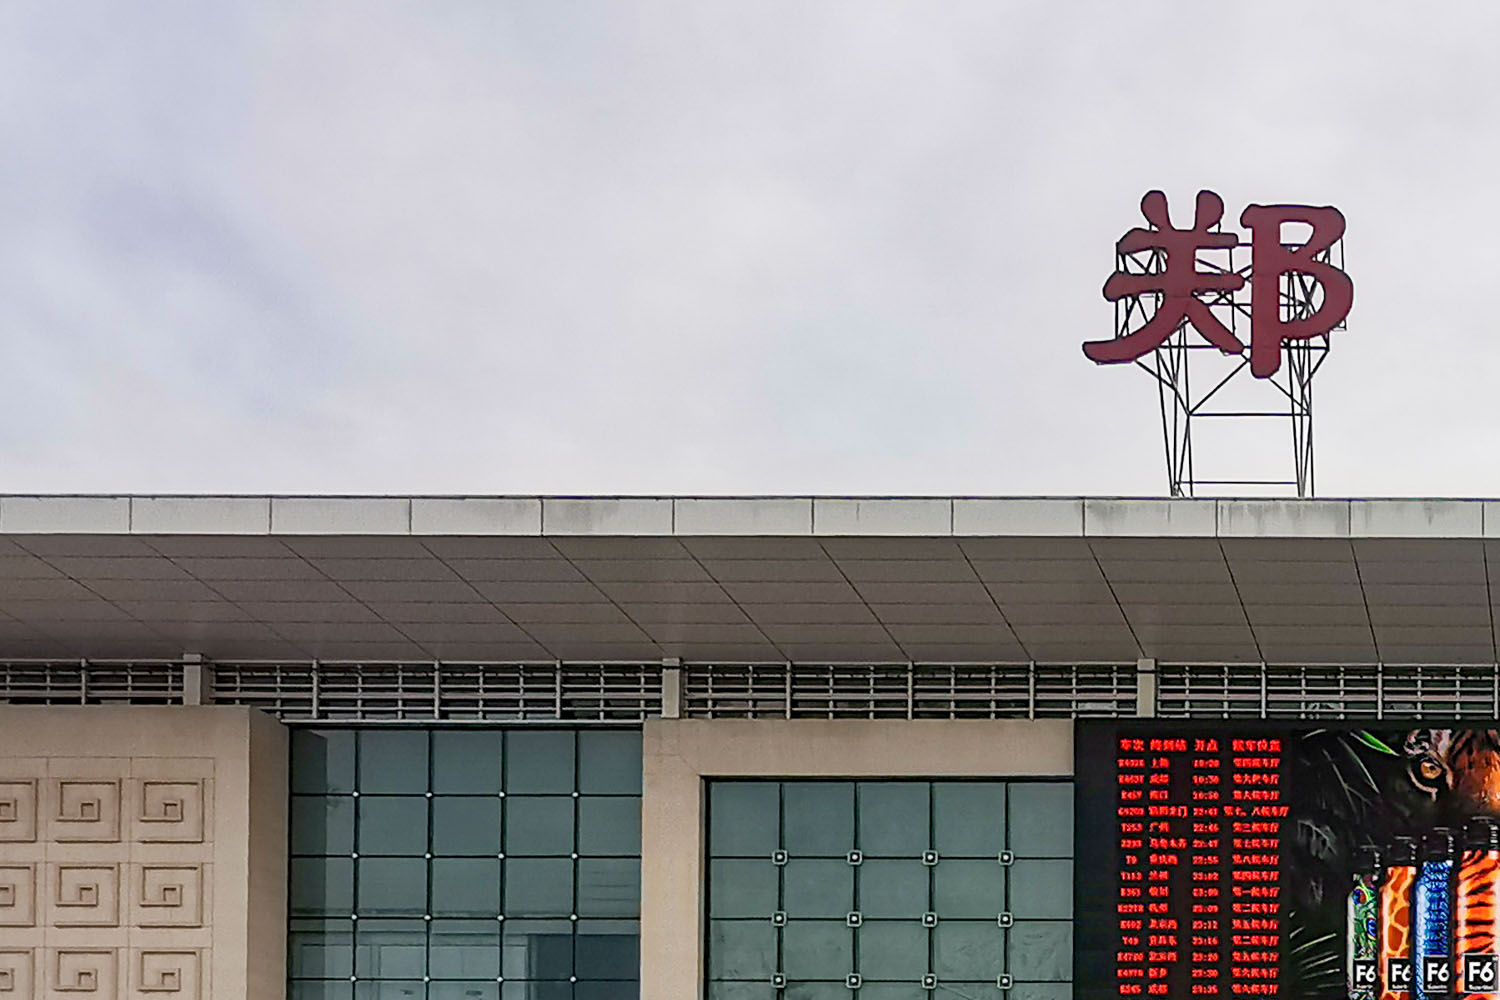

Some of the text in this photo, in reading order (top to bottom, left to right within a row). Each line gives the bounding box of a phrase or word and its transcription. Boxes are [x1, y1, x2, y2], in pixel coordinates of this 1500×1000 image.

[1120, 739, 1145, 752] 车次
[1356, 965, 1376, 982] F6
[1427, 963, 1450, 982] F6
[1469, 961, 1494, 982] F6
